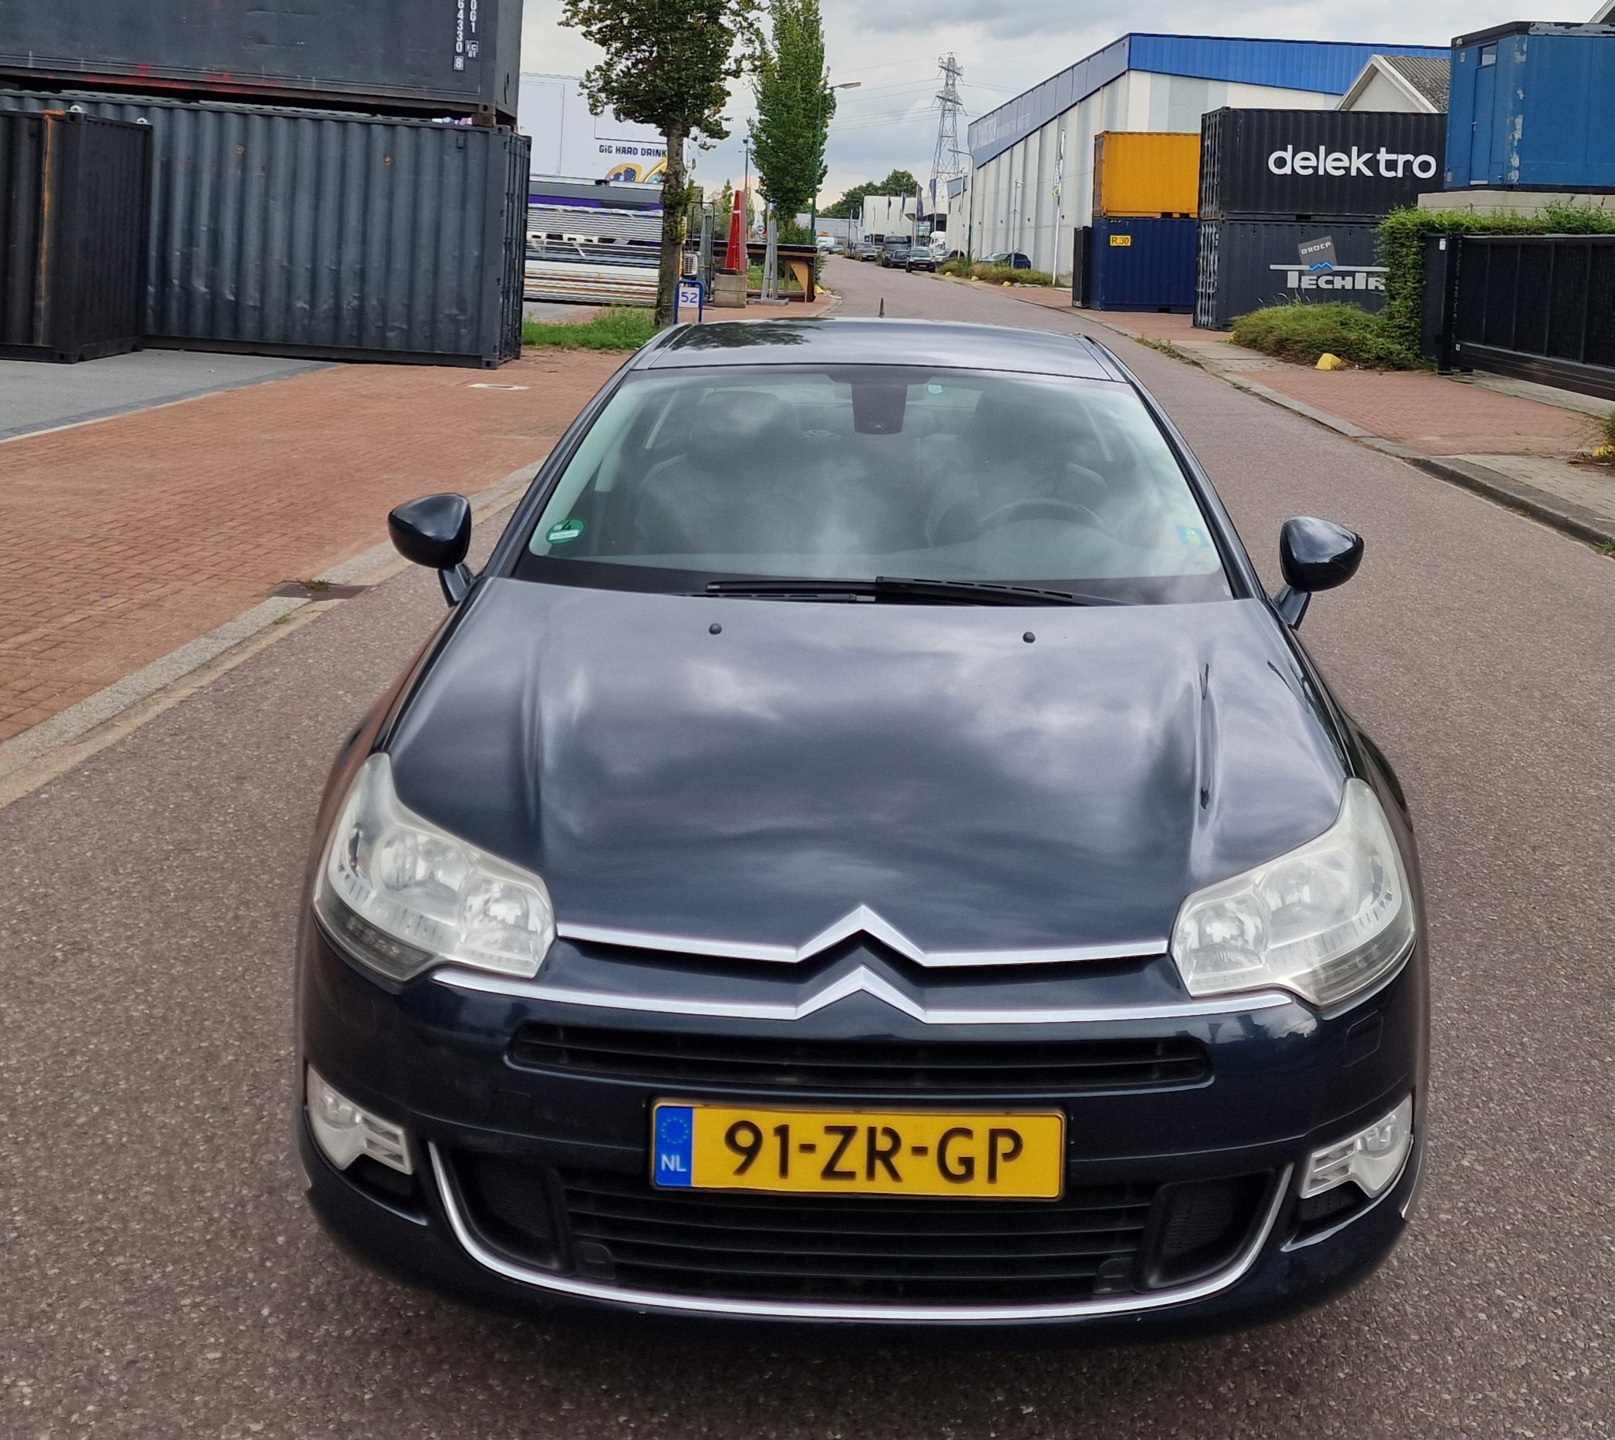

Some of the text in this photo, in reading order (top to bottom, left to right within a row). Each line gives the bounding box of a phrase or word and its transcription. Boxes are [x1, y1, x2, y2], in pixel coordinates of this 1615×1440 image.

[615, 146, 638, 155] HARD
[1268, 145, 1437, 179] delektro
[681, 292, 697, 303] 52
[724, 1120, 1024, 1185] 91-ZR-GP
[661, 1154, 687, 1172] NL
